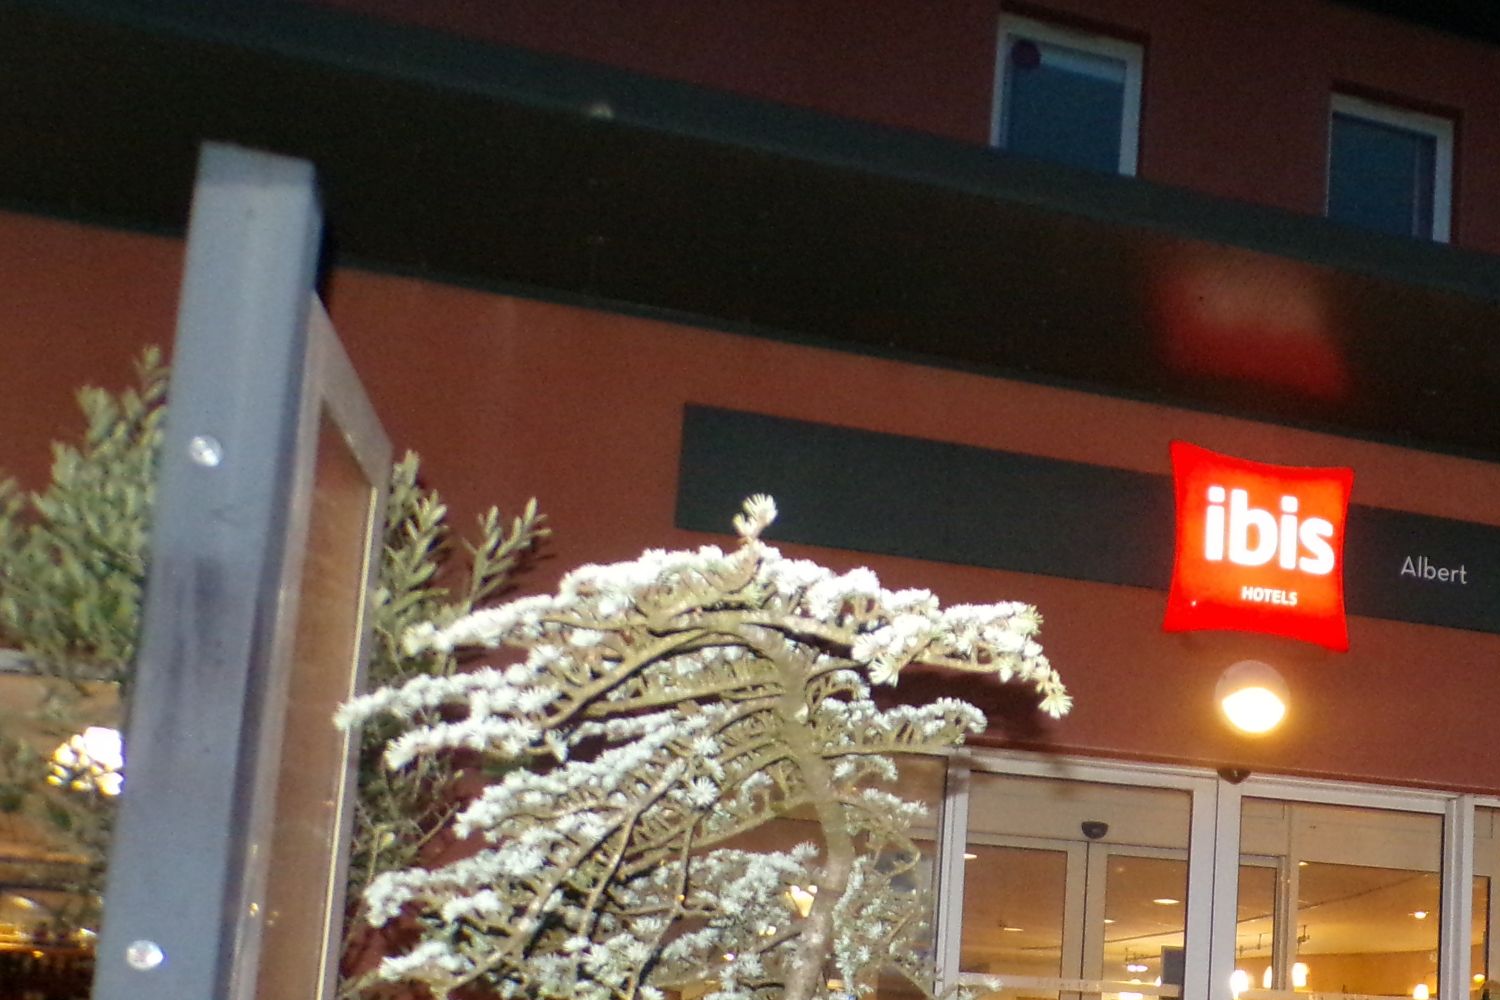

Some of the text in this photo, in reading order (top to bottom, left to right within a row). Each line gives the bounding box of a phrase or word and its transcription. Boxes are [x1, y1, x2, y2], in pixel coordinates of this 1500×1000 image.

[1204, 485, 1335, 576] ibis
[1400, 555, 1468, 585] Albert
[1241, 585, 1298, 606] HOTELS
